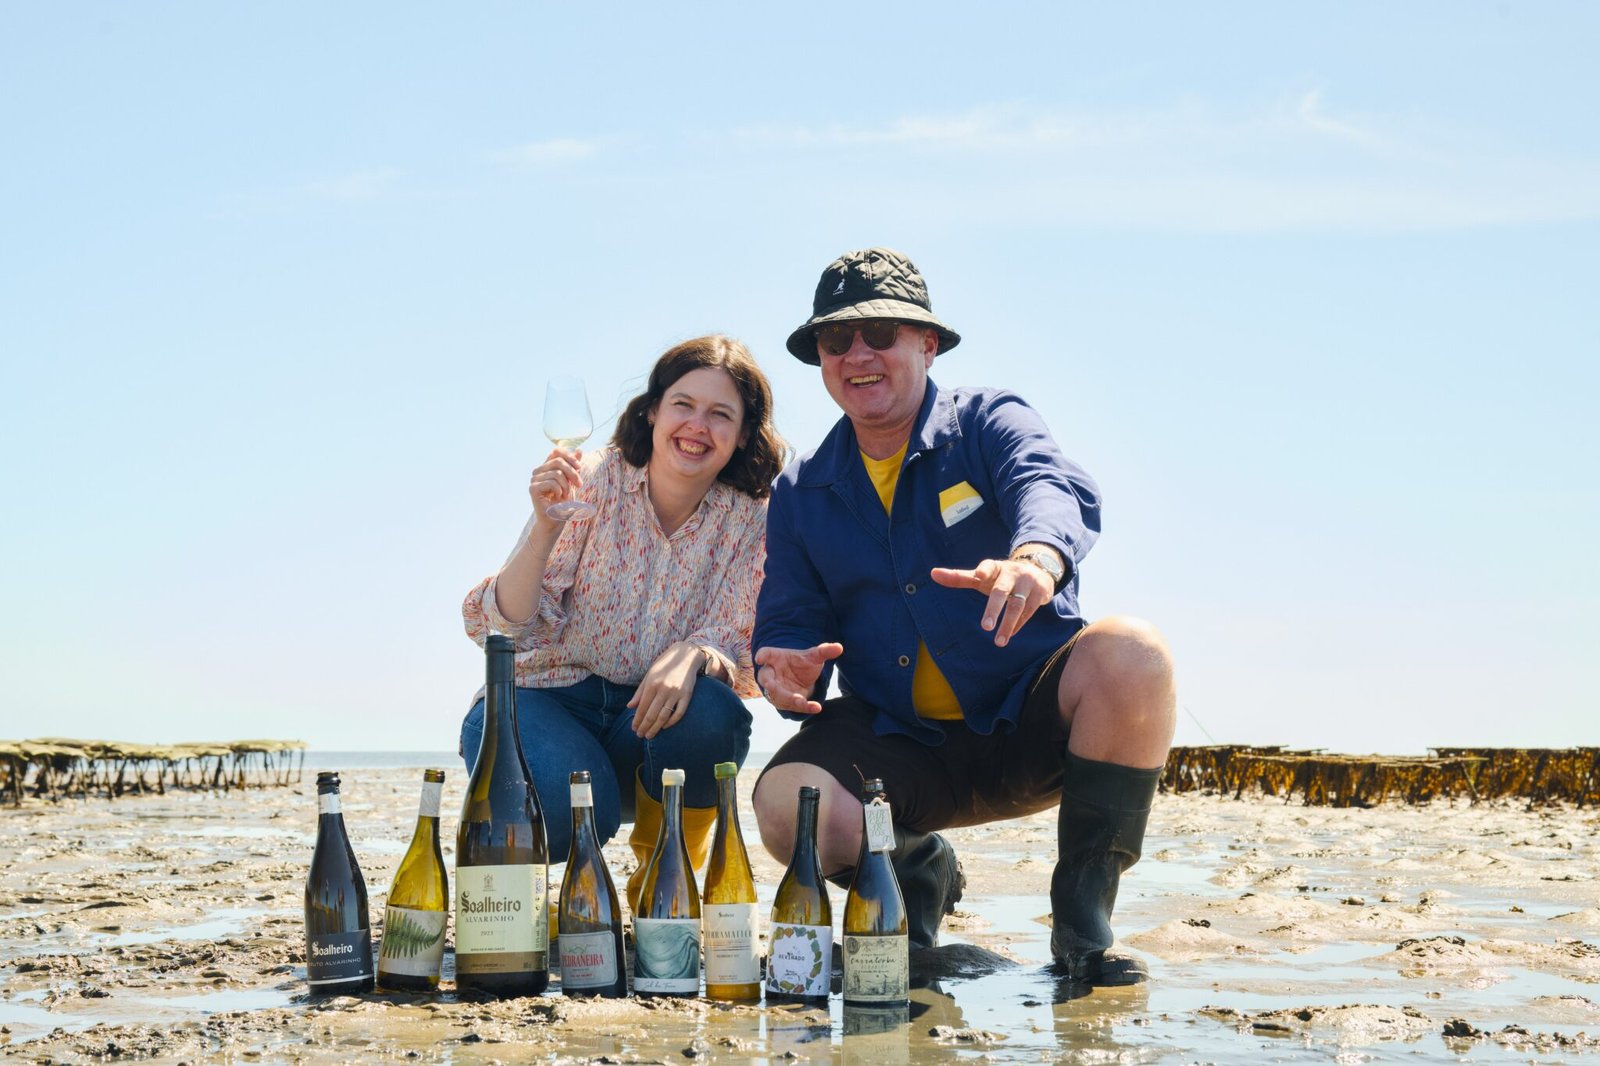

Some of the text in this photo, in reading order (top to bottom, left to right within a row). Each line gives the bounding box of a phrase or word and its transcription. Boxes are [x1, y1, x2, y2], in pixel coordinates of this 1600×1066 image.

[461, 890, 521, 916] Soalheiro
[465, 915, 514, 923] ALVARINHO
[312, 941, 353, 958] Soalheiro
[324, 957, 361, 966] ALVARINHO
